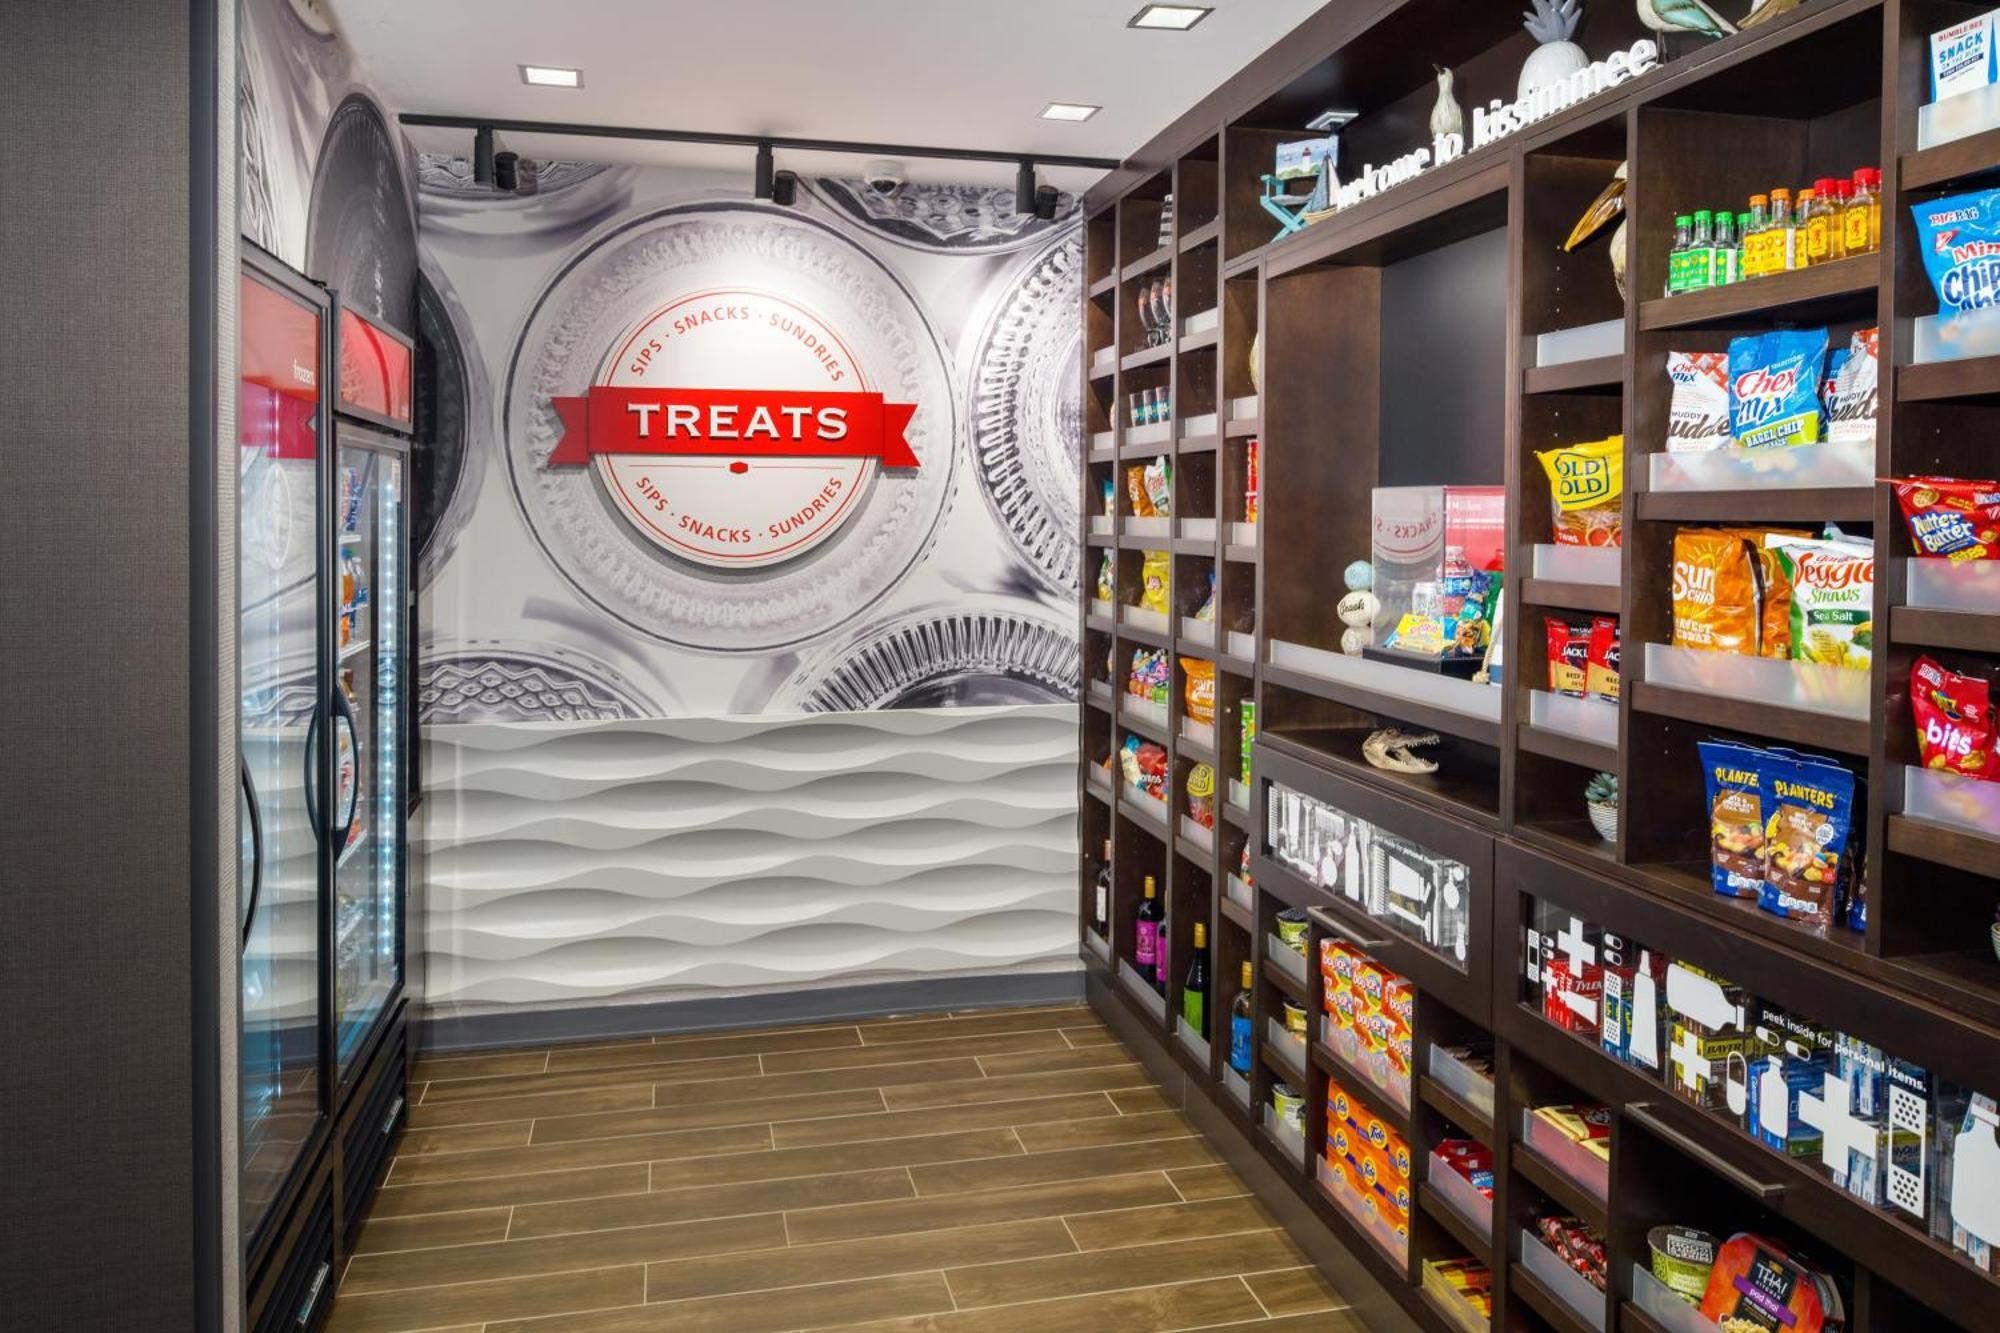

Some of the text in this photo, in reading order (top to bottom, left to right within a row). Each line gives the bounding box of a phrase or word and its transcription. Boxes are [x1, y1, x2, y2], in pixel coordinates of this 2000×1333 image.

[1939, 31, 1984, 63] SNACK
[1432, 132, 1464, 167] to
[1471, 39, 1658, 152] kissimmee
[1930, 206, 1980, 227] BIG BAG
[1952, 241, 2000, 265] Min
[630, 306, 846, 383] SIPS SNACKS SUNDRIES
[1736, 361, 1802, 399] Chex
[627, 402, 848, 441] TREATS
[1737, 391, 1792, 427] mix
[1746, 431, 1777, 448] BAGEL
[1777, 419, 1804, 437] CHIP
[1558, 460, 1602, 479] OLD
[1559, 477, 1603, 496] OLD
[635, 476, 843, 543] SIPS SNACKS SUNDRIES
[1911, 512, 1962, 537] Nutter
[1921, 522, 1974, 553] Butter
[1786, 552, 1874, 590] Veggie
[1686, 588, 1716, 606] CHIP
[1813, 610, 1854, 622] Sea Salt
[1561, 646, 1583, 658] JACK
[1603, 650, 1620, 661] JAC
[1926, 717, 1973, 756] bits
[1715, 767, 1760, 788] PLANTE
[1774, 779, 1835, 810] PLANTERS
[1707, 1041, 1742, 1055] BAYER
[1762, 1009, 1928, 1093] peek inside for personal items.
[1370, 1126, 1385, 1141] Tide
[1364, 1162, 1375, 1177] Tide
[1756, 1262, 1790, 1294] THAI
[1749, 1288, 1765, 1304] pad
